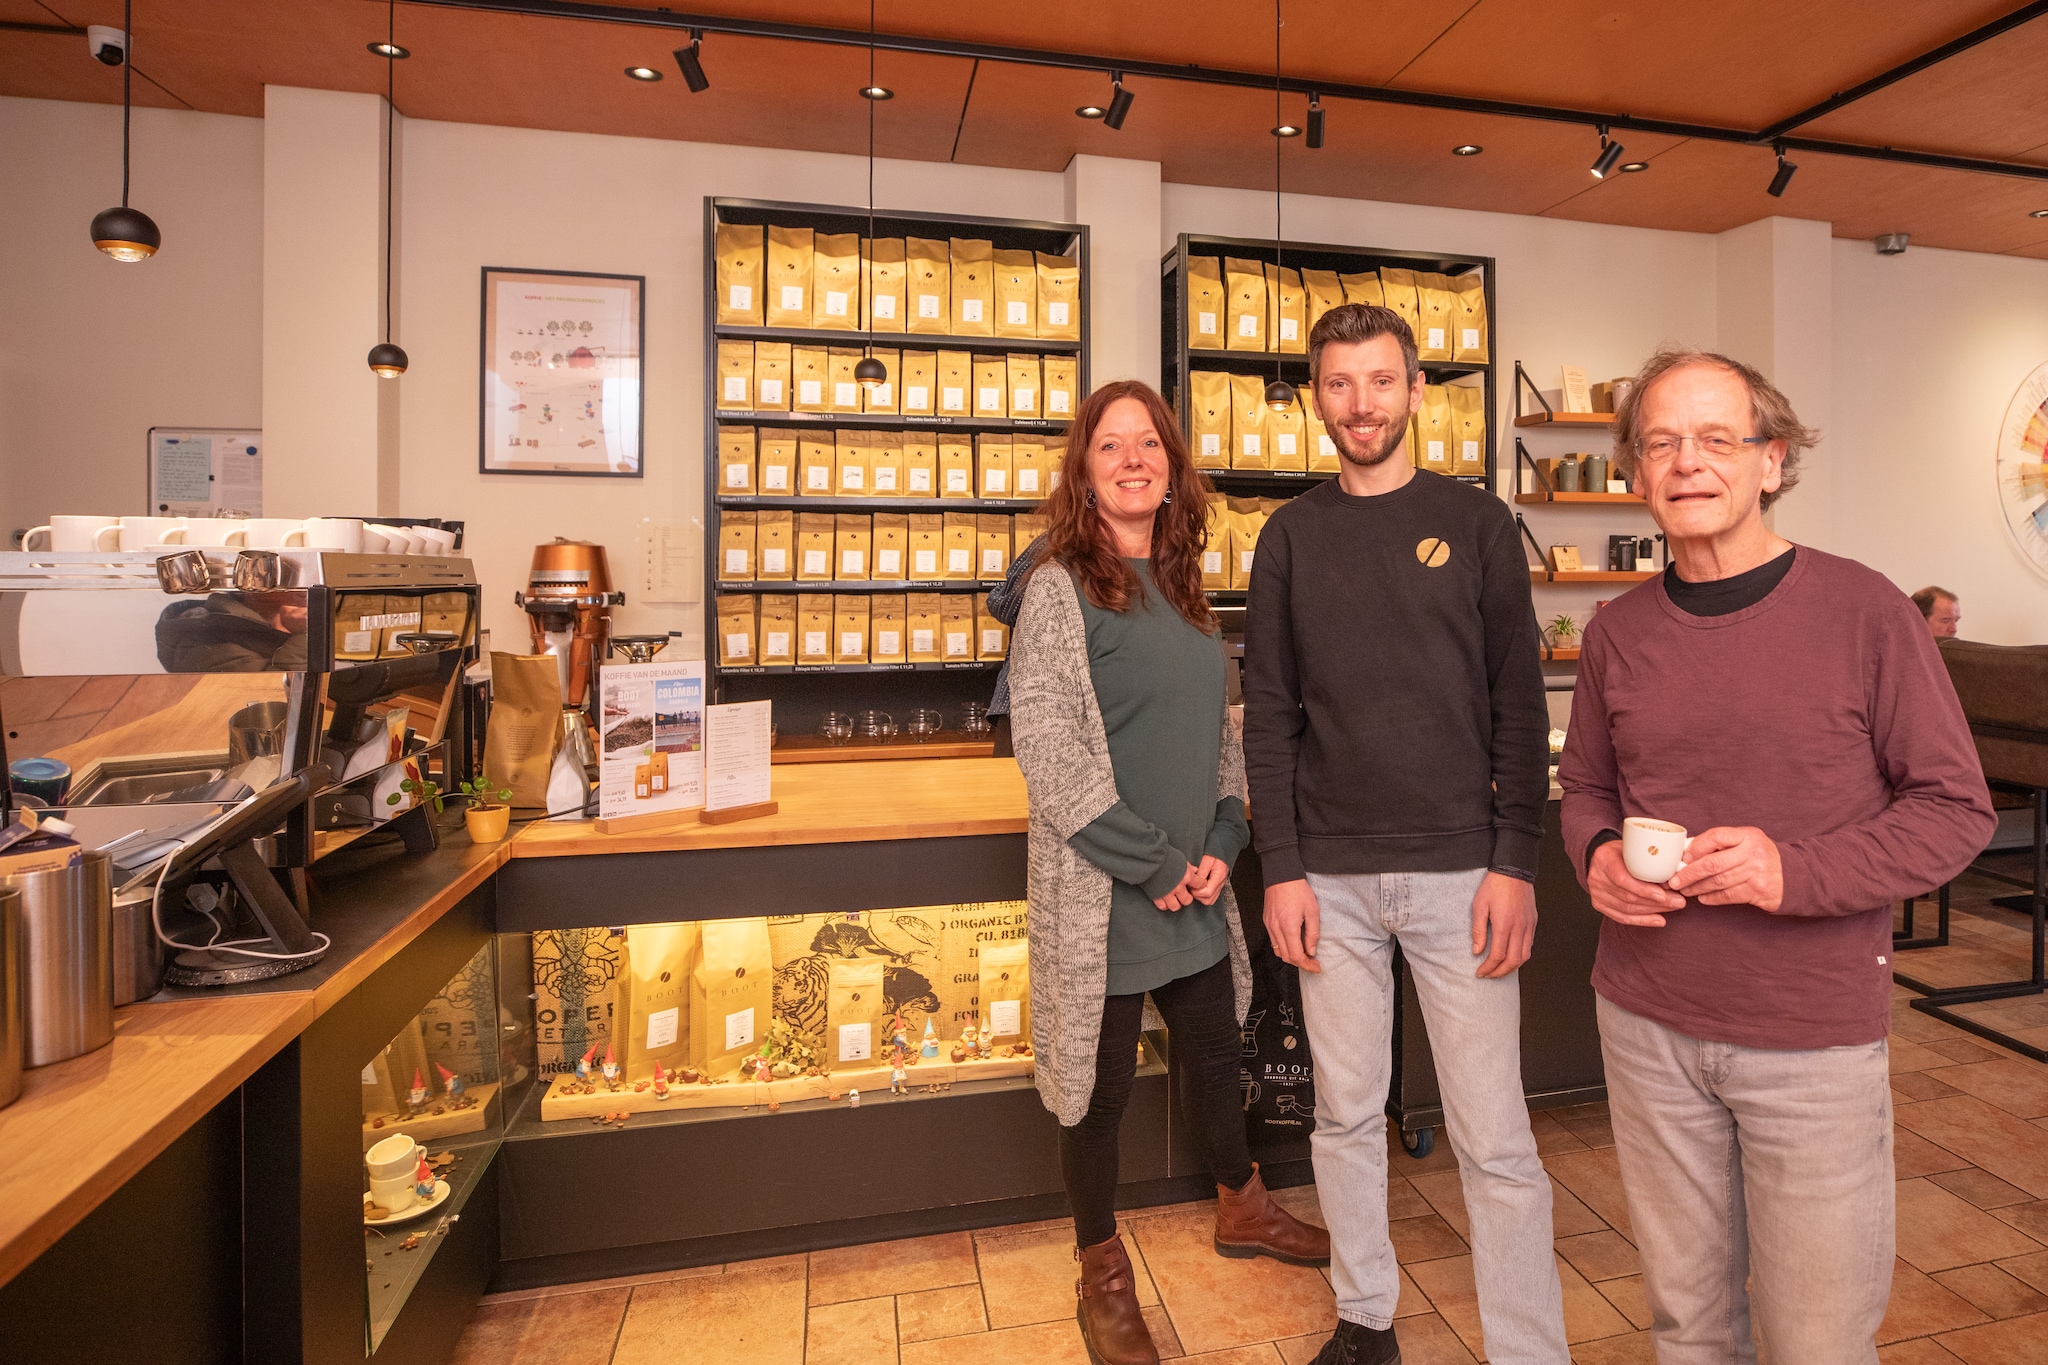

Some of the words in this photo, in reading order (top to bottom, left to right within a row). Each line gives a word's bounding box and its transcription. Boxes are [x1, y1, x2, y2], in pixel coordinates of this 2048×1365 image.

[604, 671, 632, 681] KOFFIE
[632, 670, 649, 679] VAN
[650, 670, 660, 678] DE
[661, 668, 688, 677] MAAND
[618, 690, 641, 702] BOOT
[657, 686, 700, 699] COLOMBIA
[950, 915, 1011, 929] ORGANIC
[646, 986, 684, 1002] BOOT
[721, 981, 759, 997] BOOT
[990, 986, 1020, 995] BOOT
[840, 1007, 872, 1016] BOOT
